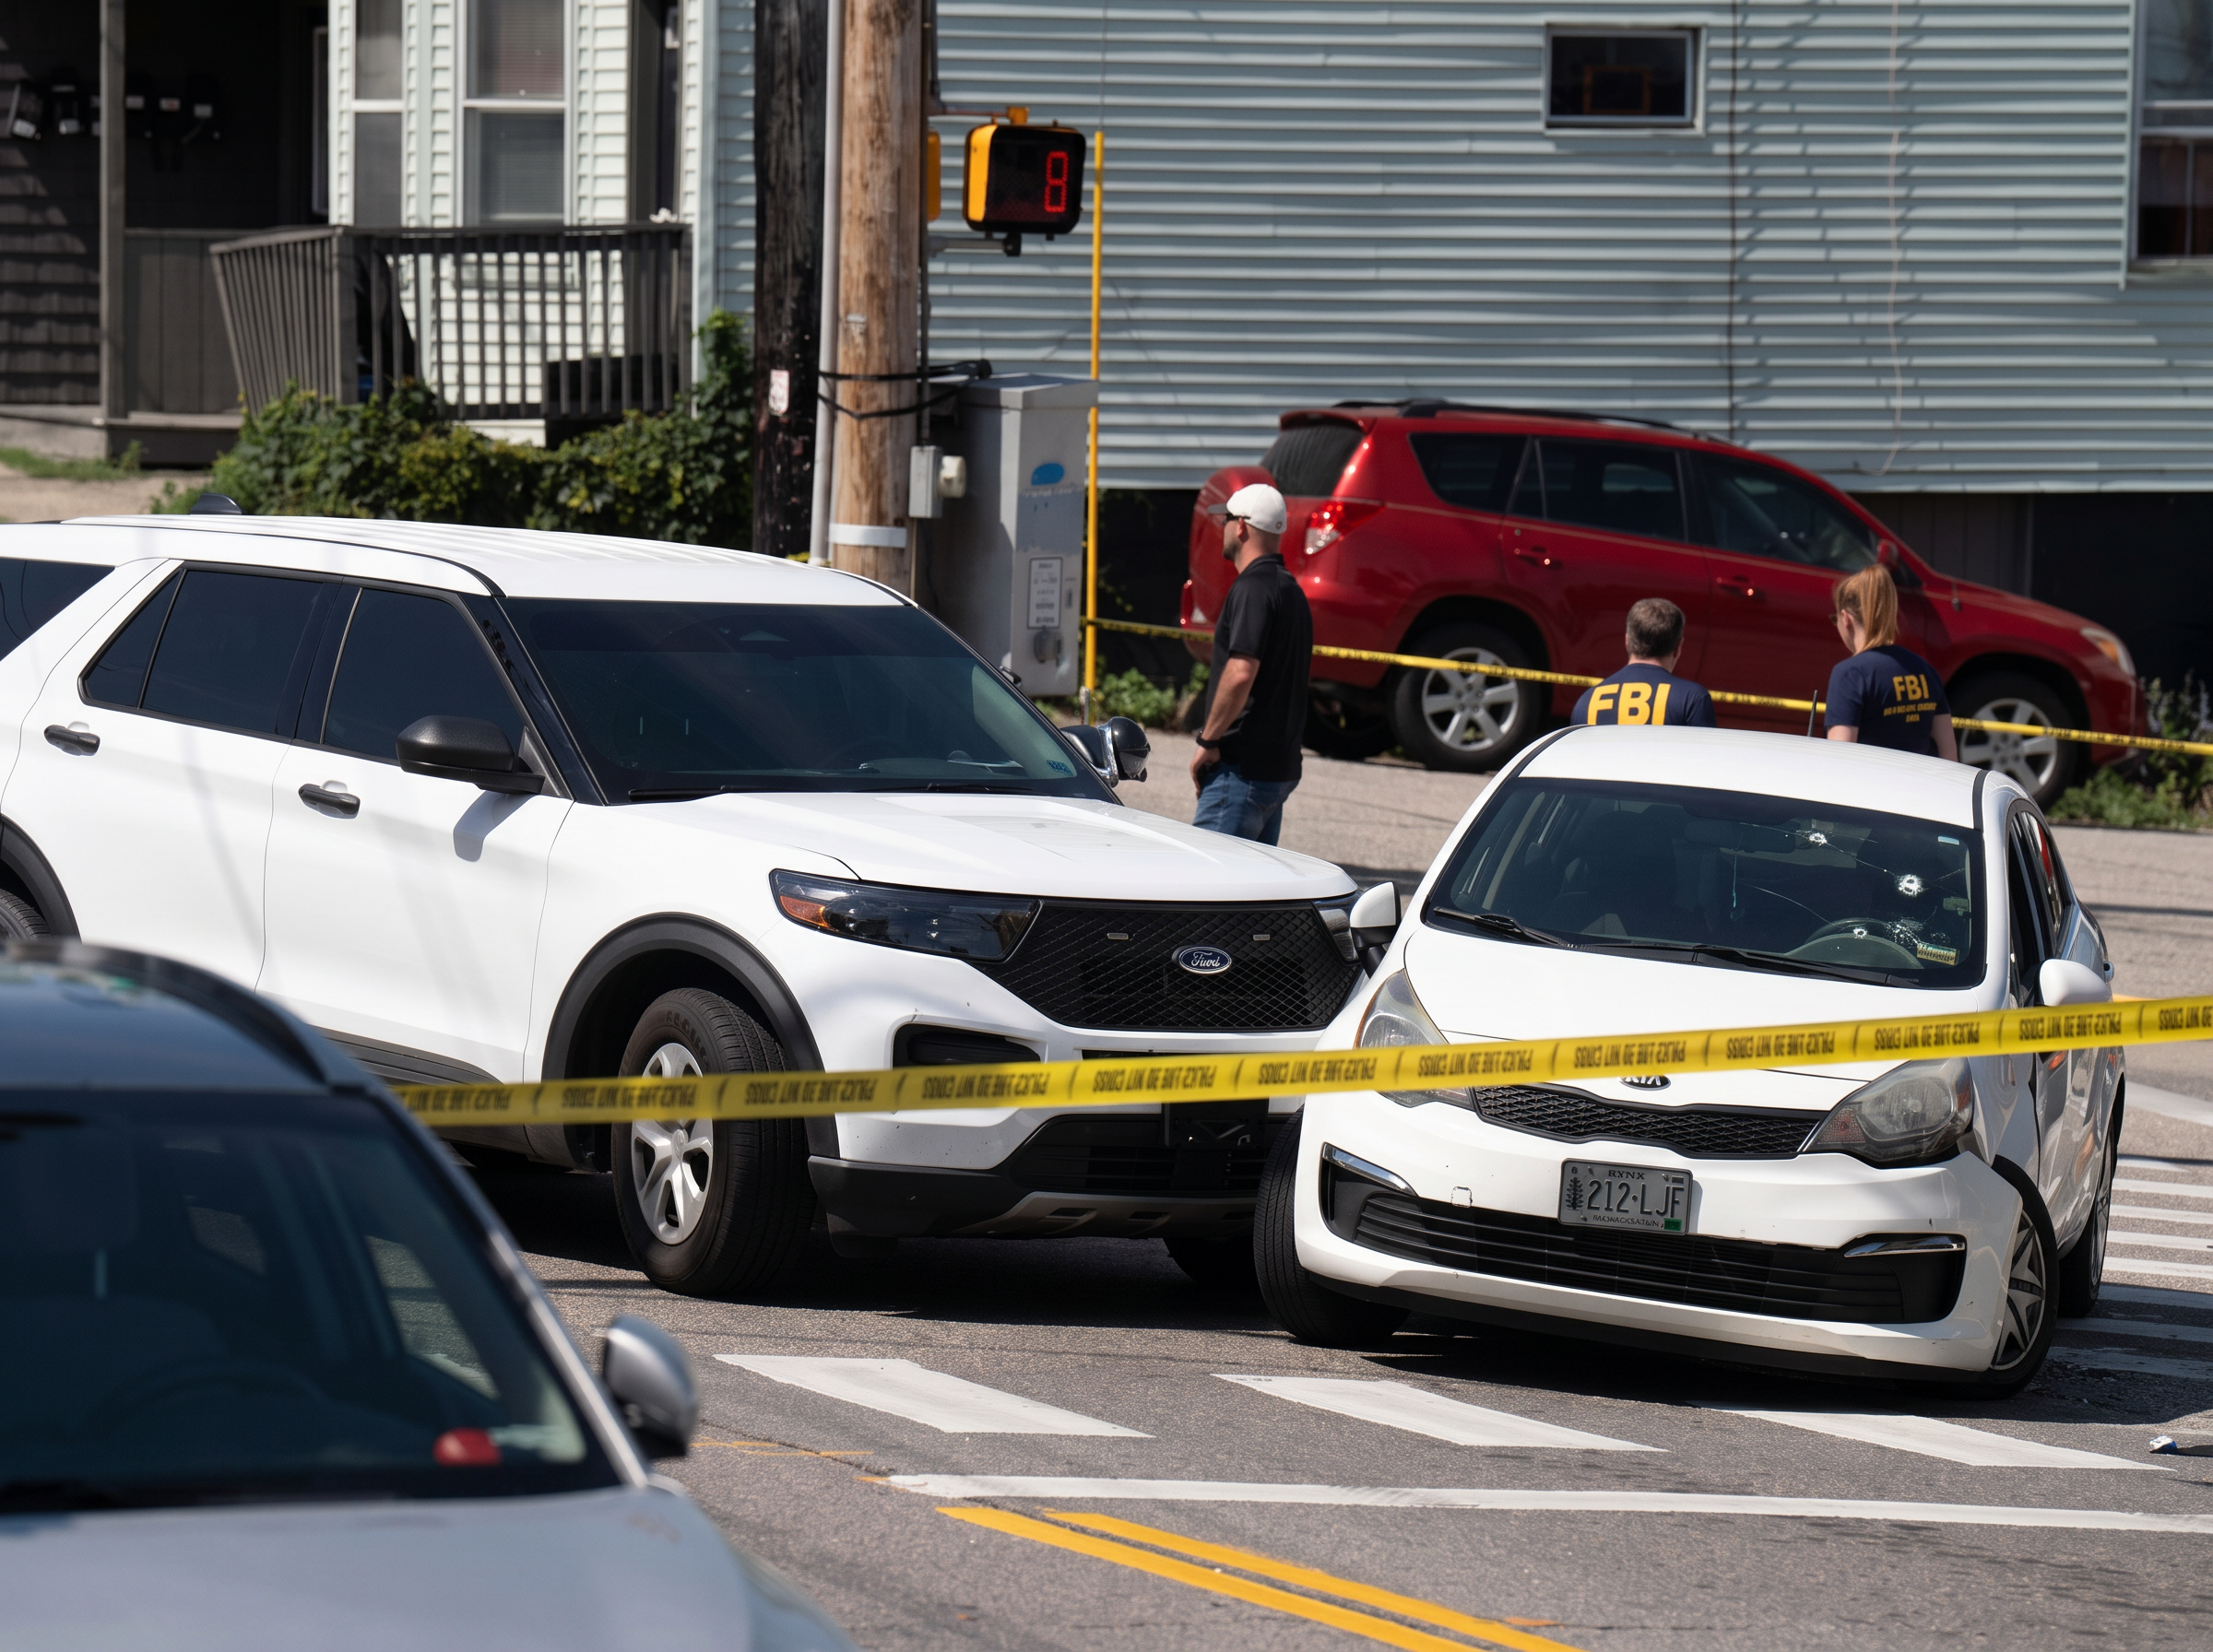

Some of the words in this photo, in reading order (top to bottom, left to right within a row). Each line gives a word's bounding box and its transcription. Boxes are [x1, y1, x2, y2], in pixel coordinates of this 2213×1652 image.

[1044, 150, 1069, 213] 8
[1587, 681, 1672, 726] FBI
[1892, 674, 1930, 702] FBI
